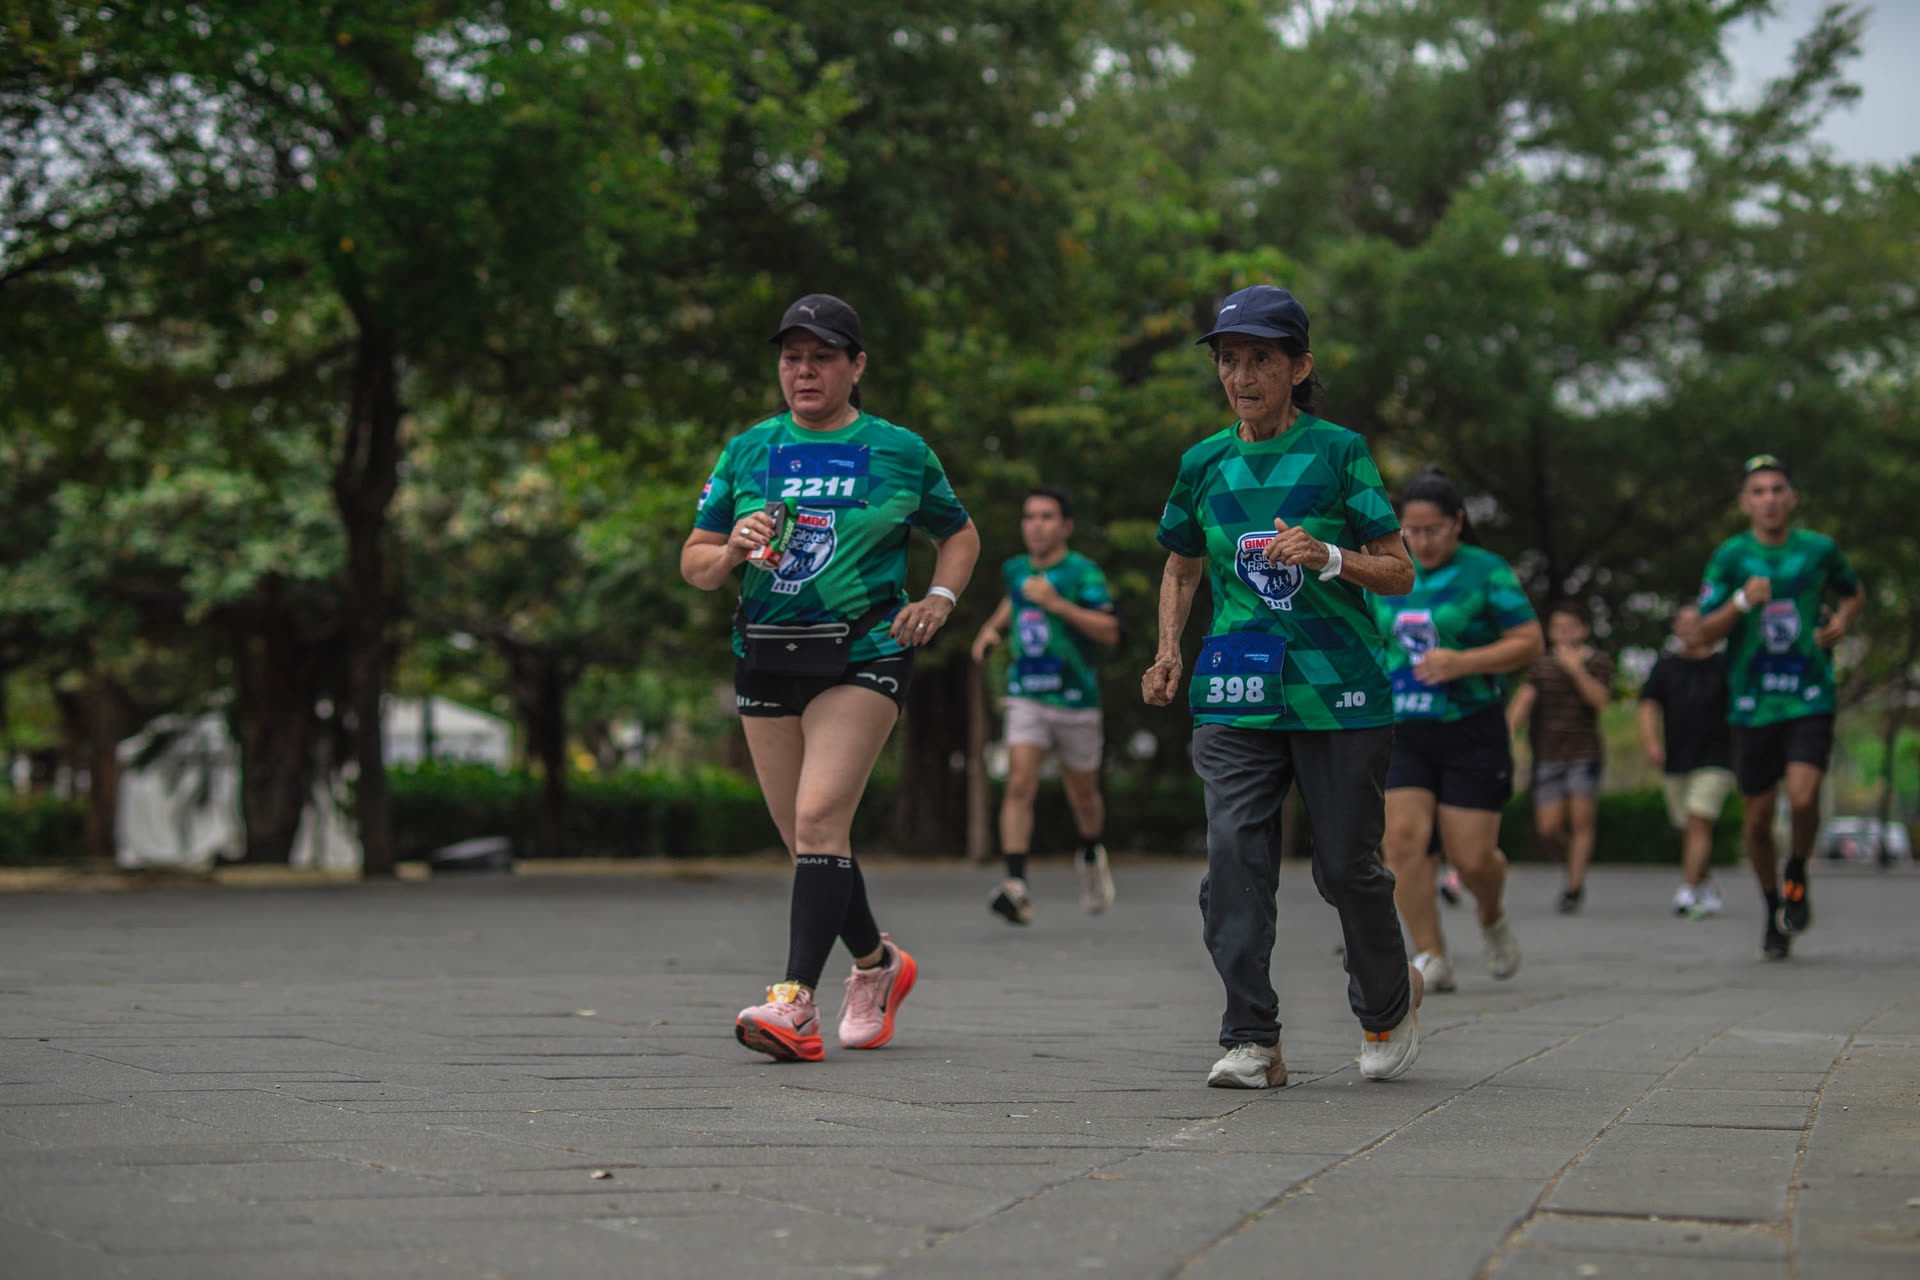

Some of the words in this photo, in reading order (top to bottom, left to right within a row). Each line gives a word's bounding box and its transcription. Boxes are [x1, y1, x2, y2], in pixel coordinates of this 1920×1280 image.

[781, 477, 856, 497] 2211
[792, 528, 830, 543] Global
[788, 540, 812, 552] ace
[1206, 676, 1265, 703] 398
